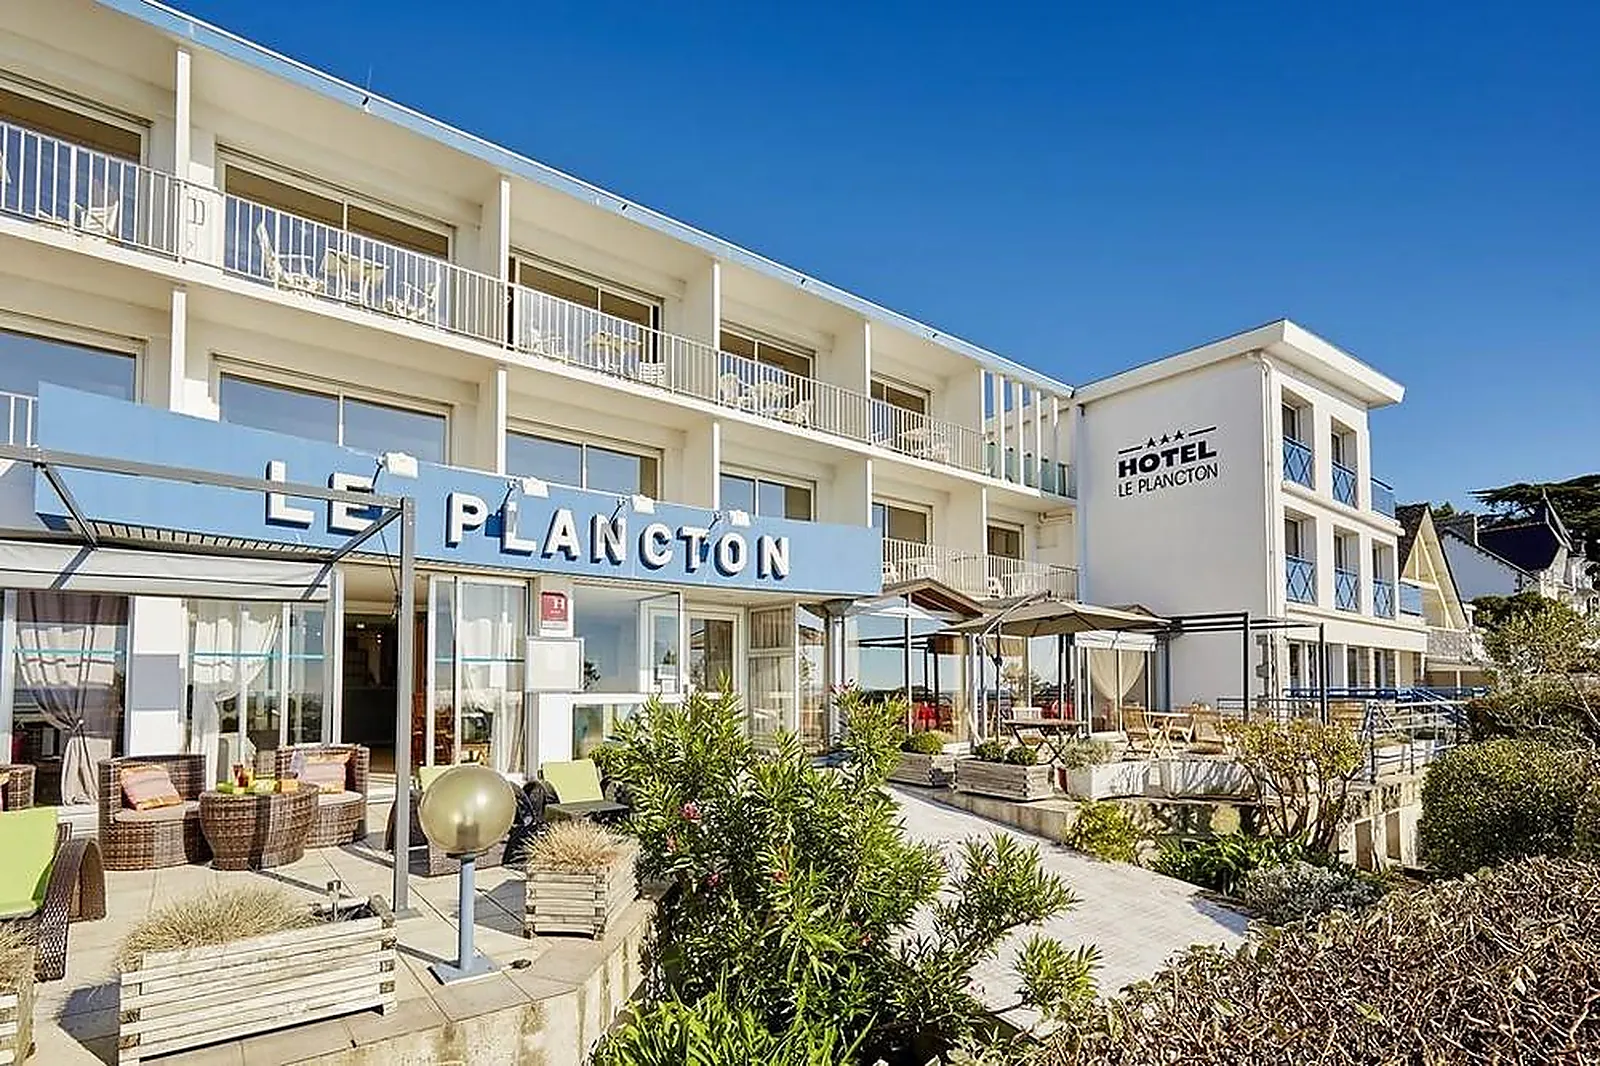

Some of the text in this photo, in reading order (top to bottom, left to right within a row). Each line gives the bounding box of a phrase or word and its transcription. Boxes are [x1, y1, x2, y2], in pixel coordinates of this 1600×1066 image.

[1118, 440, 1217, 478] HOTEL
[1118, 462, 1218, 497] LE PLANCTON
[265, 460, 790, 580] LE PLANCTON
